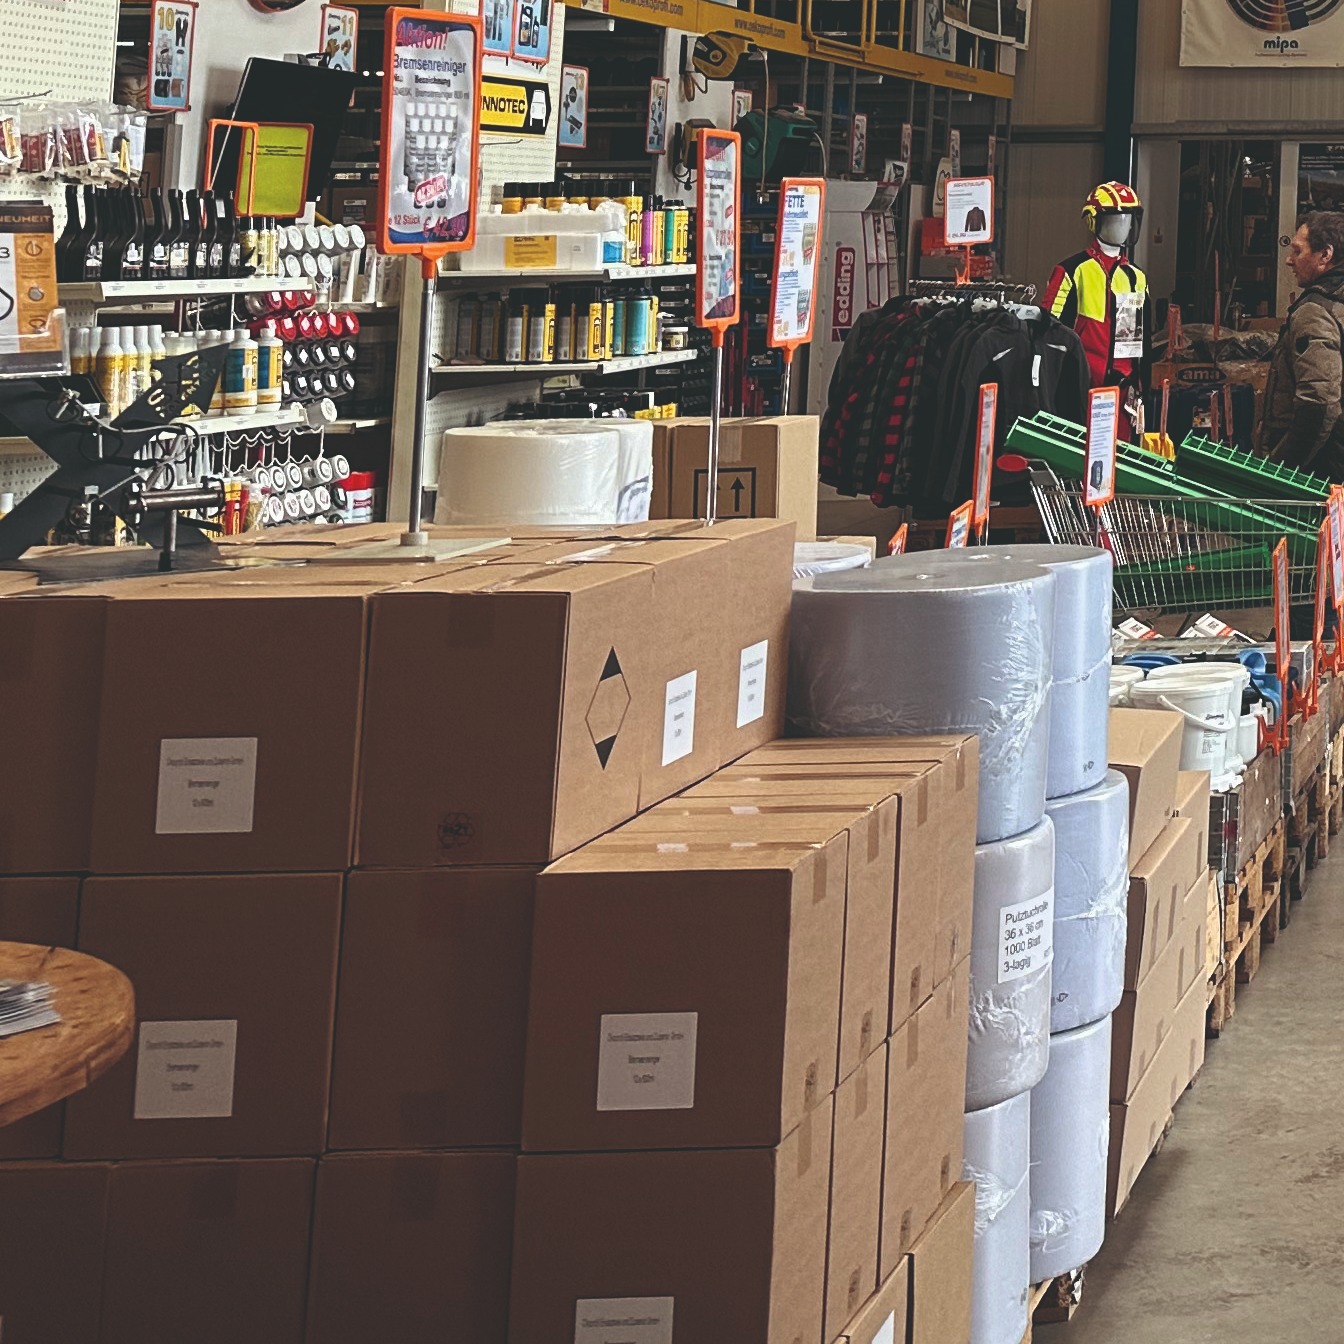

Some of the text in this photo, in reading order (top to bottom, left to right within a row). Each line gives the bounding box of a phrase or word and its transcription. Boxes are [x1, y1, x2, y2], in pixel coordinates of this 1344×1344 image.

[158, 7, 174, 31] 10
[341, 15, 354, 36] 11
[397, 21, 449, 51] Aktion!
[1264, 36, 1299, 53] mipa
[394, 54, 467, 76] Bremsenreiniger
[403, 213, 420, 226] Stück
[837, 251, 854, 323] edding
[1182, 369, 1220, 380] ama
[1004, 928, 1017, 941] 36
[1018, 928, 1024, 937] x
[1004, 941, 1026, 956] 1000
